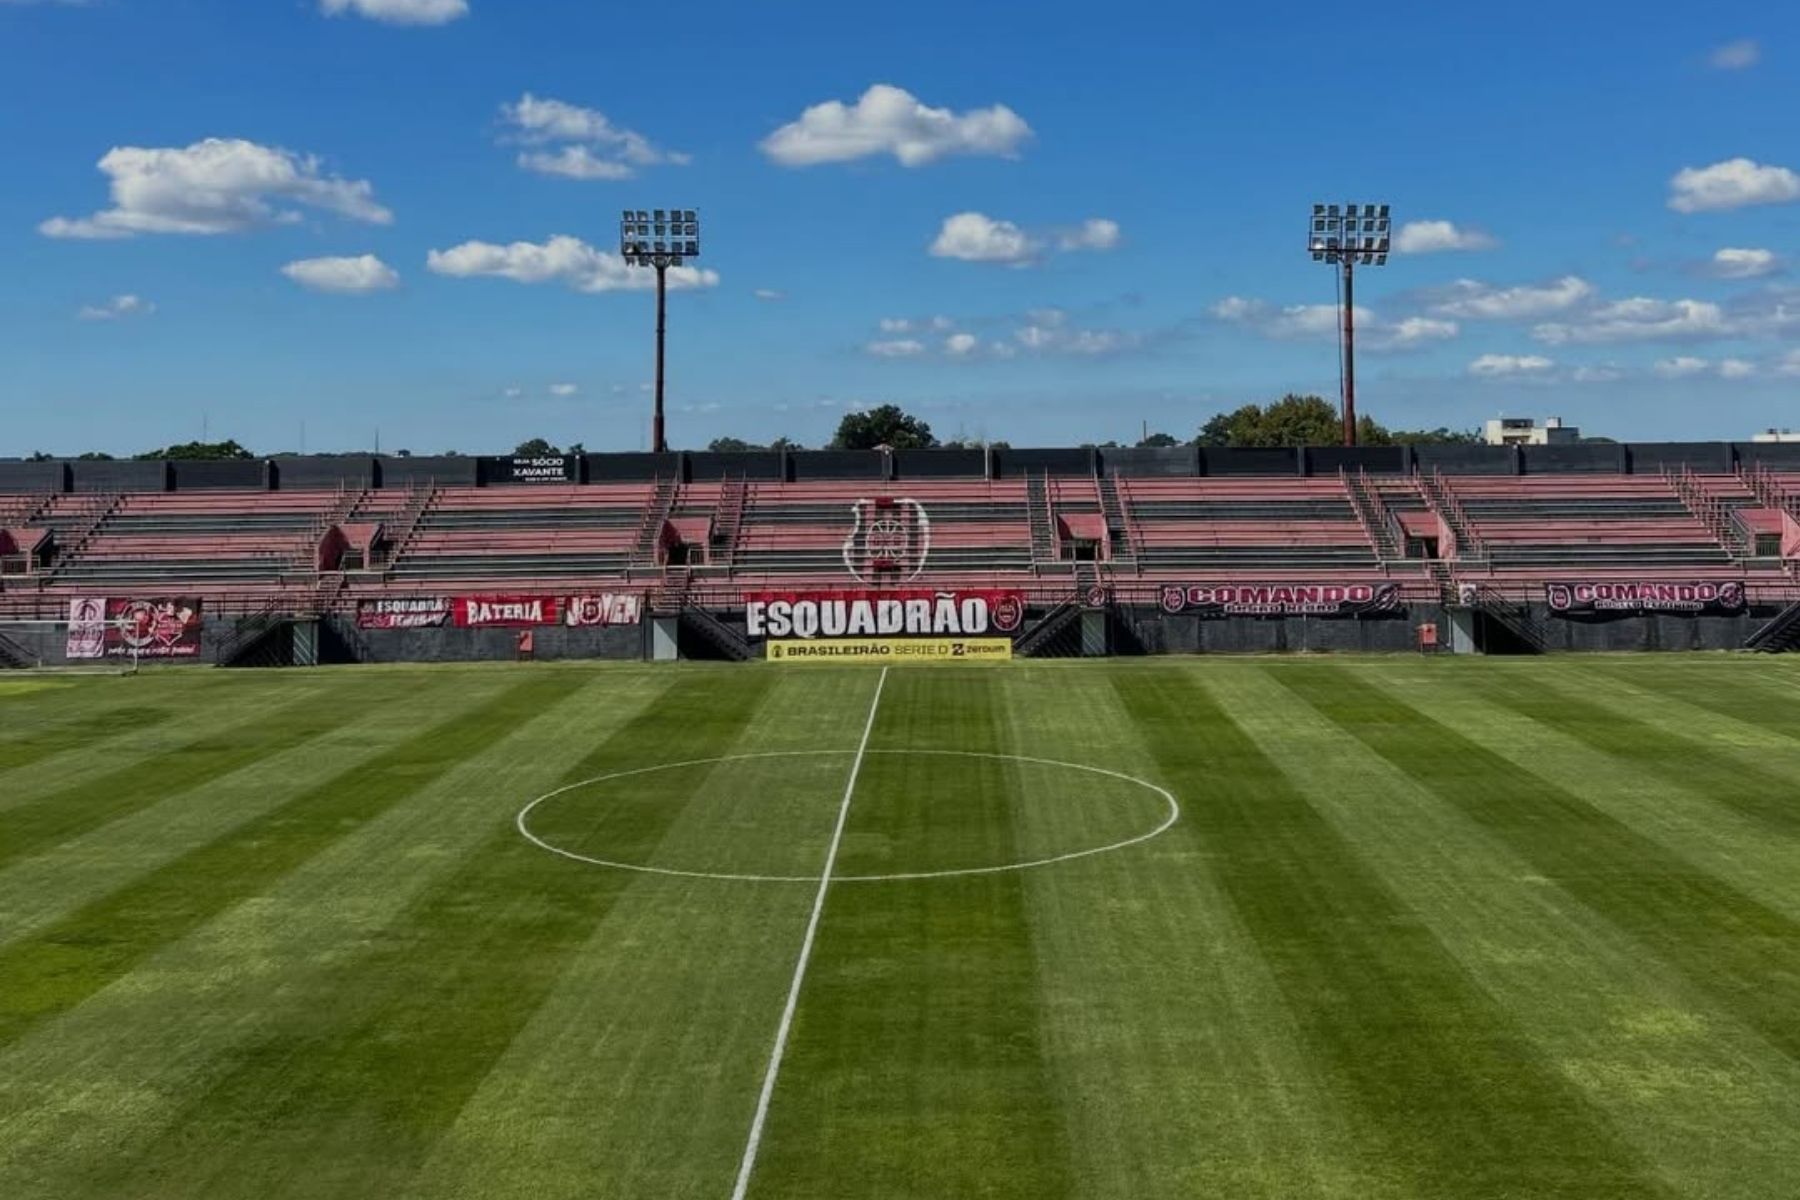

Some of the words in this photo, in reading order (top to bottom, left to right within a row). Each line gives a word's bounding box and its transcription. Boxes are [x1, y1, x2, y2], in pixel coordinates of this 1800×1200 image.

[531, 456, 564, 466] SÓCIO
[512, 467, 565, 477] XAVANTE
[1187, 585, 1374, 604] COMANDO
[1573, 583, 1717, 602] COMANDO
[467, 600, 542, 625] BATERIA
[747, 592, 988, 639] ESQUADRÃO
[787, 643, 890, 657] BRASILEIRÃO
[938, 645, 949, 655] D
